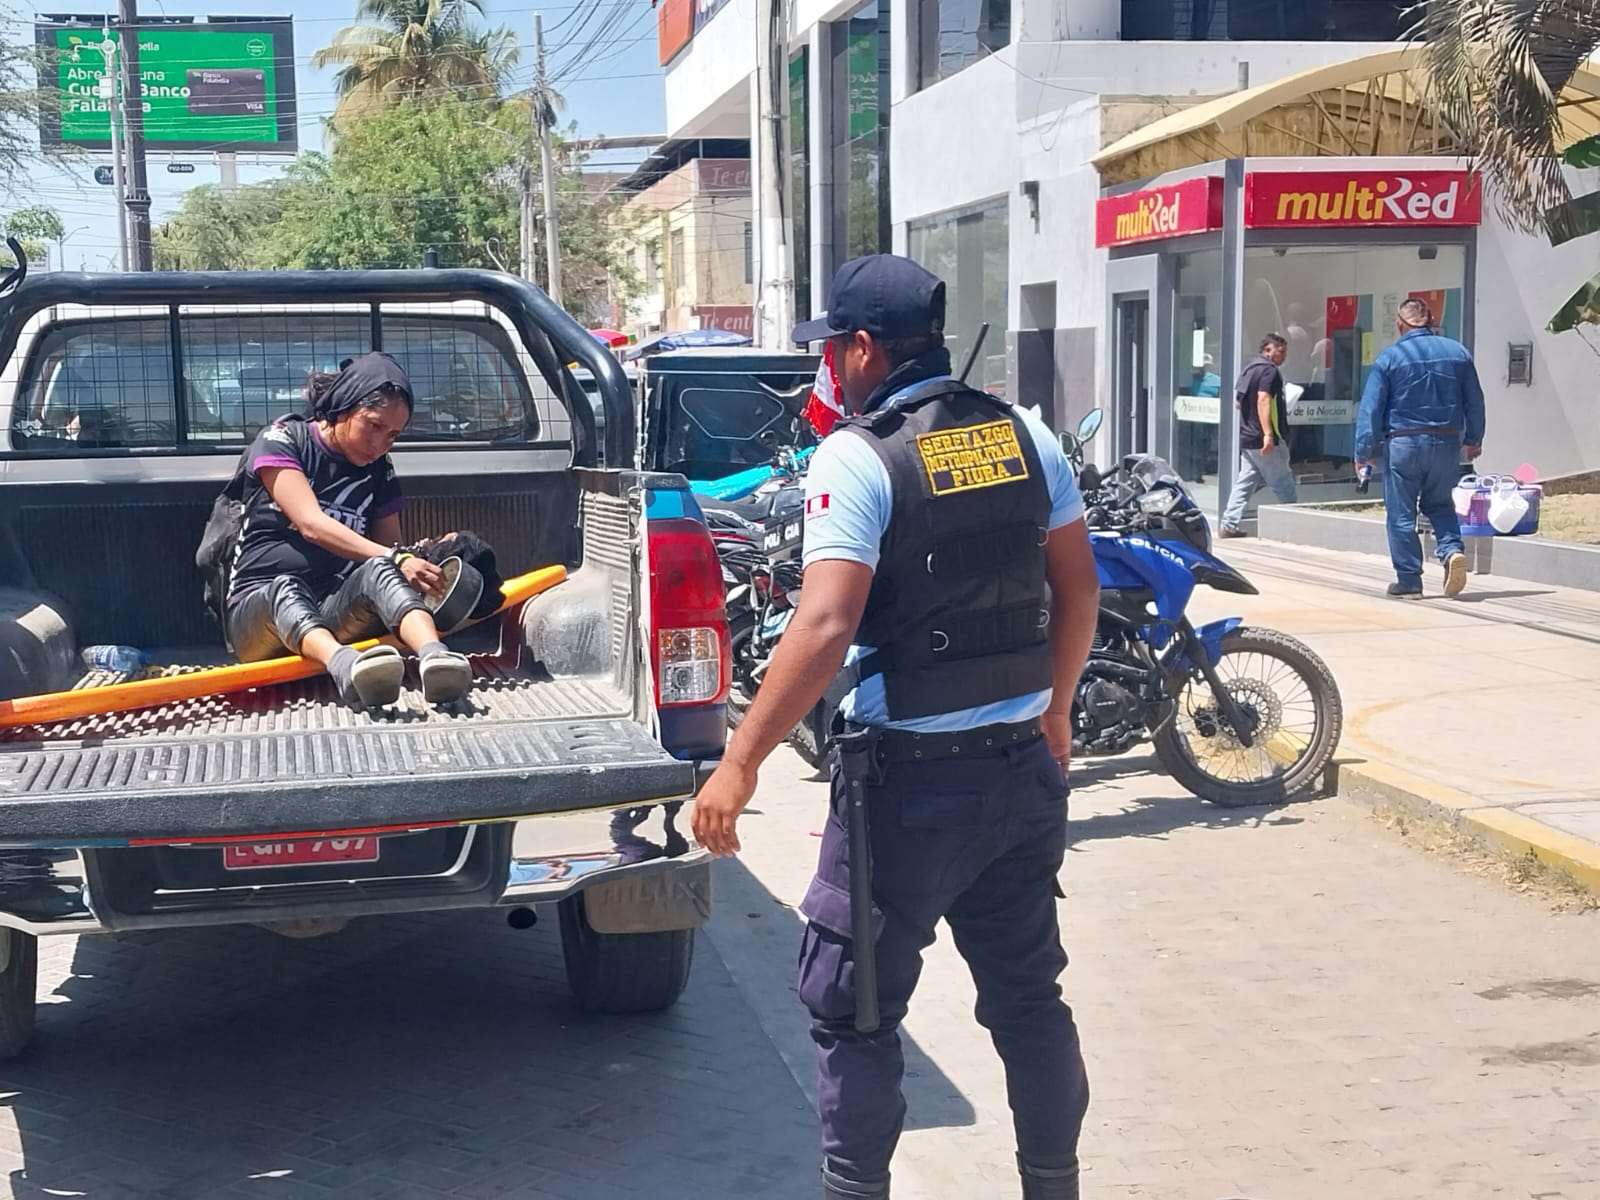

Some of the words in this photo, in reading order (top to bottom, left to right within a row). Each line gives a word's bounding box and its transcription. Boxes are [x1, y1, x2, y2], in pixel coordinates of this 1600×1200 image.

[1115, 192, 1180, 240] multiRed
[1293, 404, 1305, 416] de
[1306, 404, 1315, 416] la
[926, 442, 1019, 473] METROPOLITANO
[951, 462, 1011, 487] PIURA
